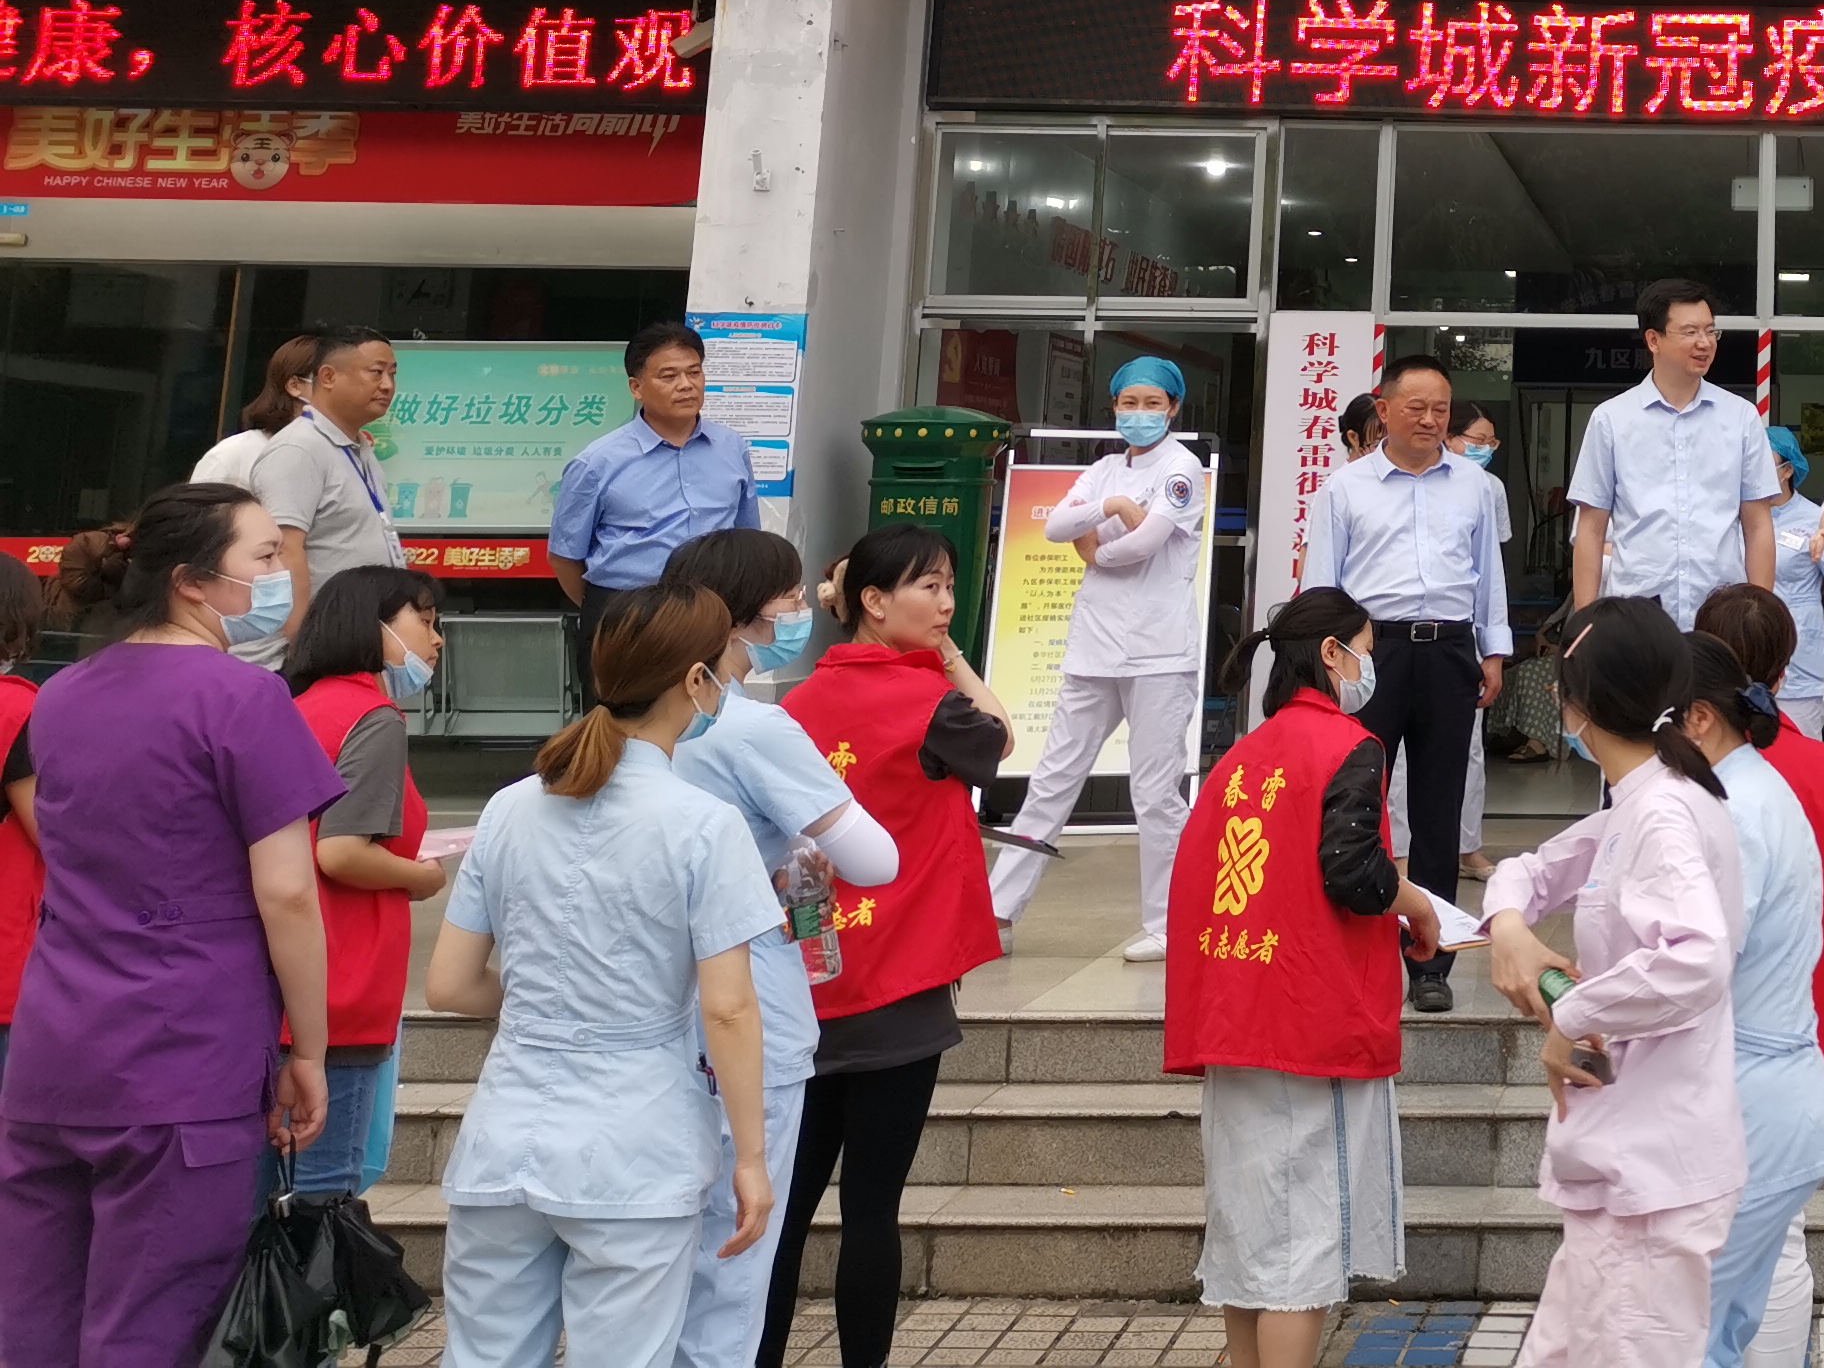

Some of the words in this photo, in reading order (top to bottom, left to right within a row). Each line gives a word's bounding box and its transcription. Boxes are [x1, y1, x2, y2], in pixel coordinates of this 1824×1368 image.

[44, 175, 90, 187] HAPPY
[93, 176, 153, 188] CHINESE
[157, 177, 188, 189] NEW
[193, 178, 228, 189] YEAR
[391, 393, 608, 427] 做好垃圾分类
[880, 495, 961, 517] 邮政信筒
[1221, 764, 1287, 812] 春雷
